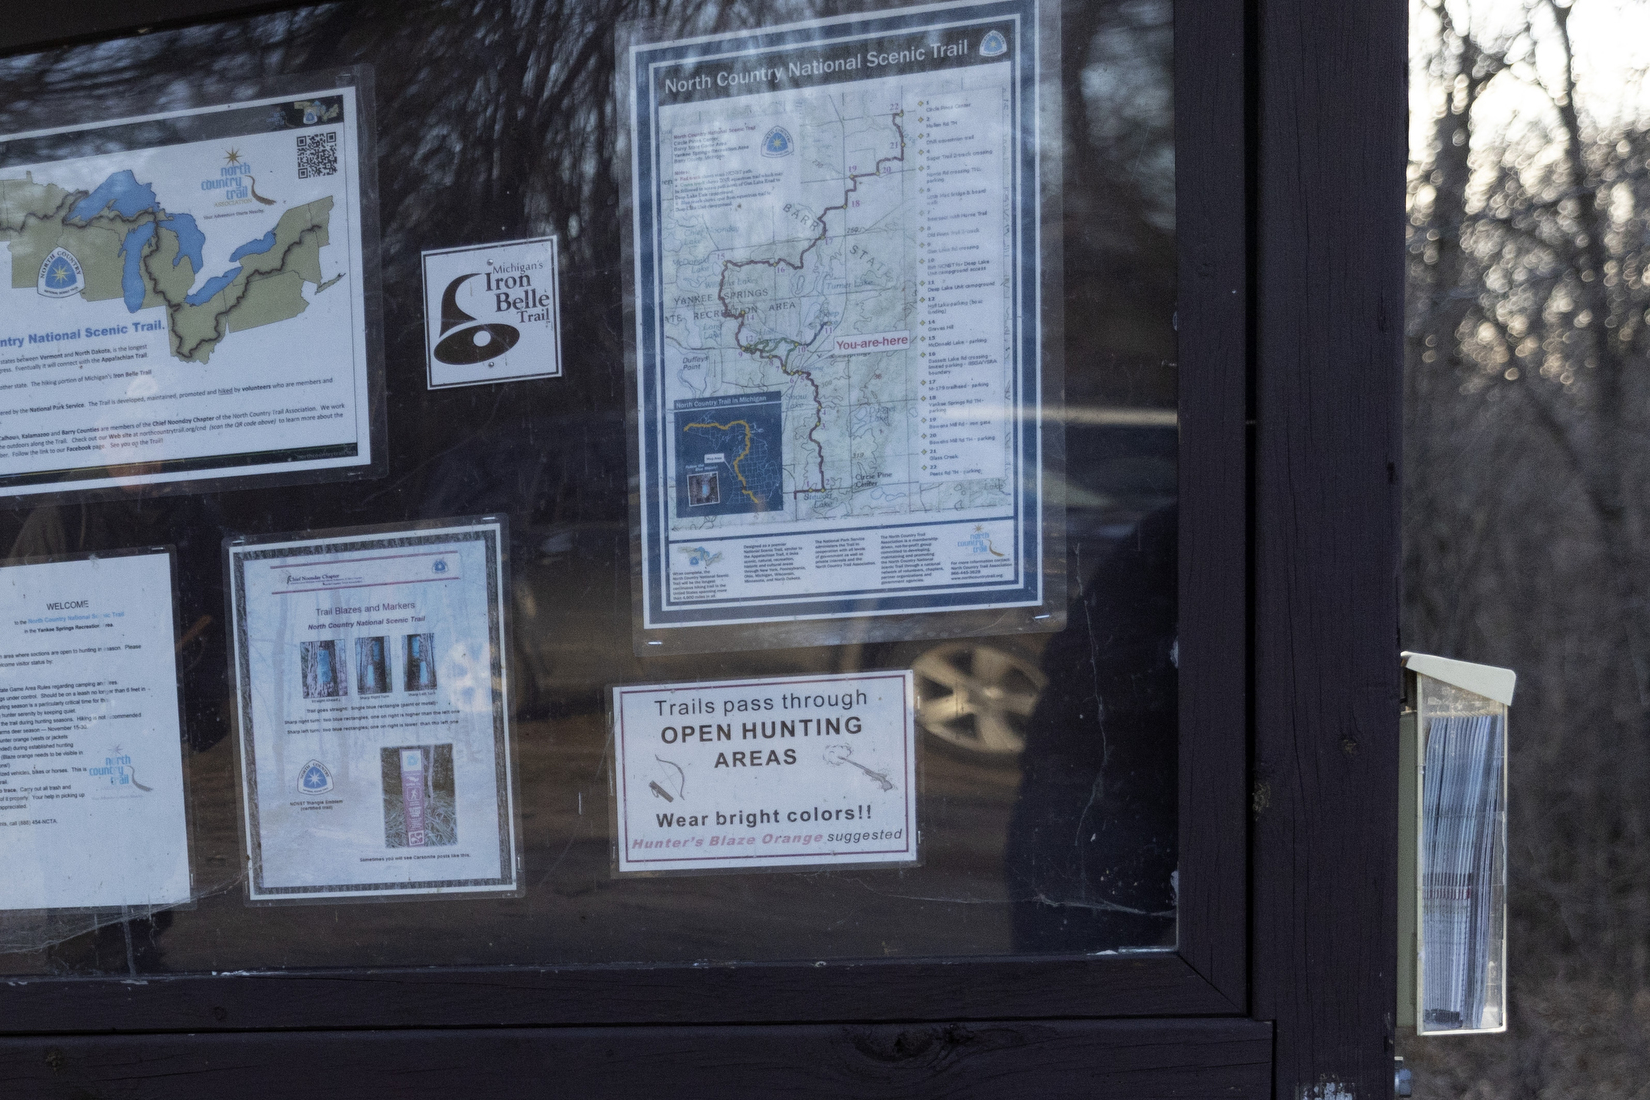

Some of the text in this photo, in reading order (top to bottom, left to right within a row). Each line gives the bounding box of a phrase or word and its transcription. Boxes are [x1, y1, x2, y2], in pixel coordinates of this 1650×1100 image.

[665, 39, 968, 93] North Country National Scenic Trail
[889, 102, 898, 110] 22
[889, 141, 898, 149] 21
[220, 162, 250, 177] north
[201, 175, 241, 192] country
[225, 185, 248, 200] trail
[851, 199, 860, 207] 18
[39, 248, 80, 278] NORTH COUNTRY
[492, 260, 543, 274] Michigan's
[484, 272, 531, 291] Iron
[494, 289, 550, 313] Belle
[674, 288, 768, 304] YANKEE SPRINGS
[768, 301, 795, 312] AREA
[517, 308, 550, 324] Trail
[28, 328, 80, 344] National
[84, 323, 128, 338] Scenic
[132, 319, 165, 333] Trail.
[836, 334, 908, 350] You-are-here
[39, 352, 62, 360] Vermont
[128, 343, 147, 352] longest
[46, 599, 88, 610] WELCOME
[315, 600, 415, 616] Trail Blazes and Markers
[328, 621, 353, 629] Country
[355, 618, 383, 626] National
[385, 616, 408, 624] Scenic
[654, 687, 867, 716] Trails pass through
[660, 716, 862, 744] OPEN HUNTING
[713, 748, 797, 768] AREAS
[655, 804, 872, 829] Wear bright colors!!
[631, 827, 902, 849] Hunter's Blaze Orange suggested
